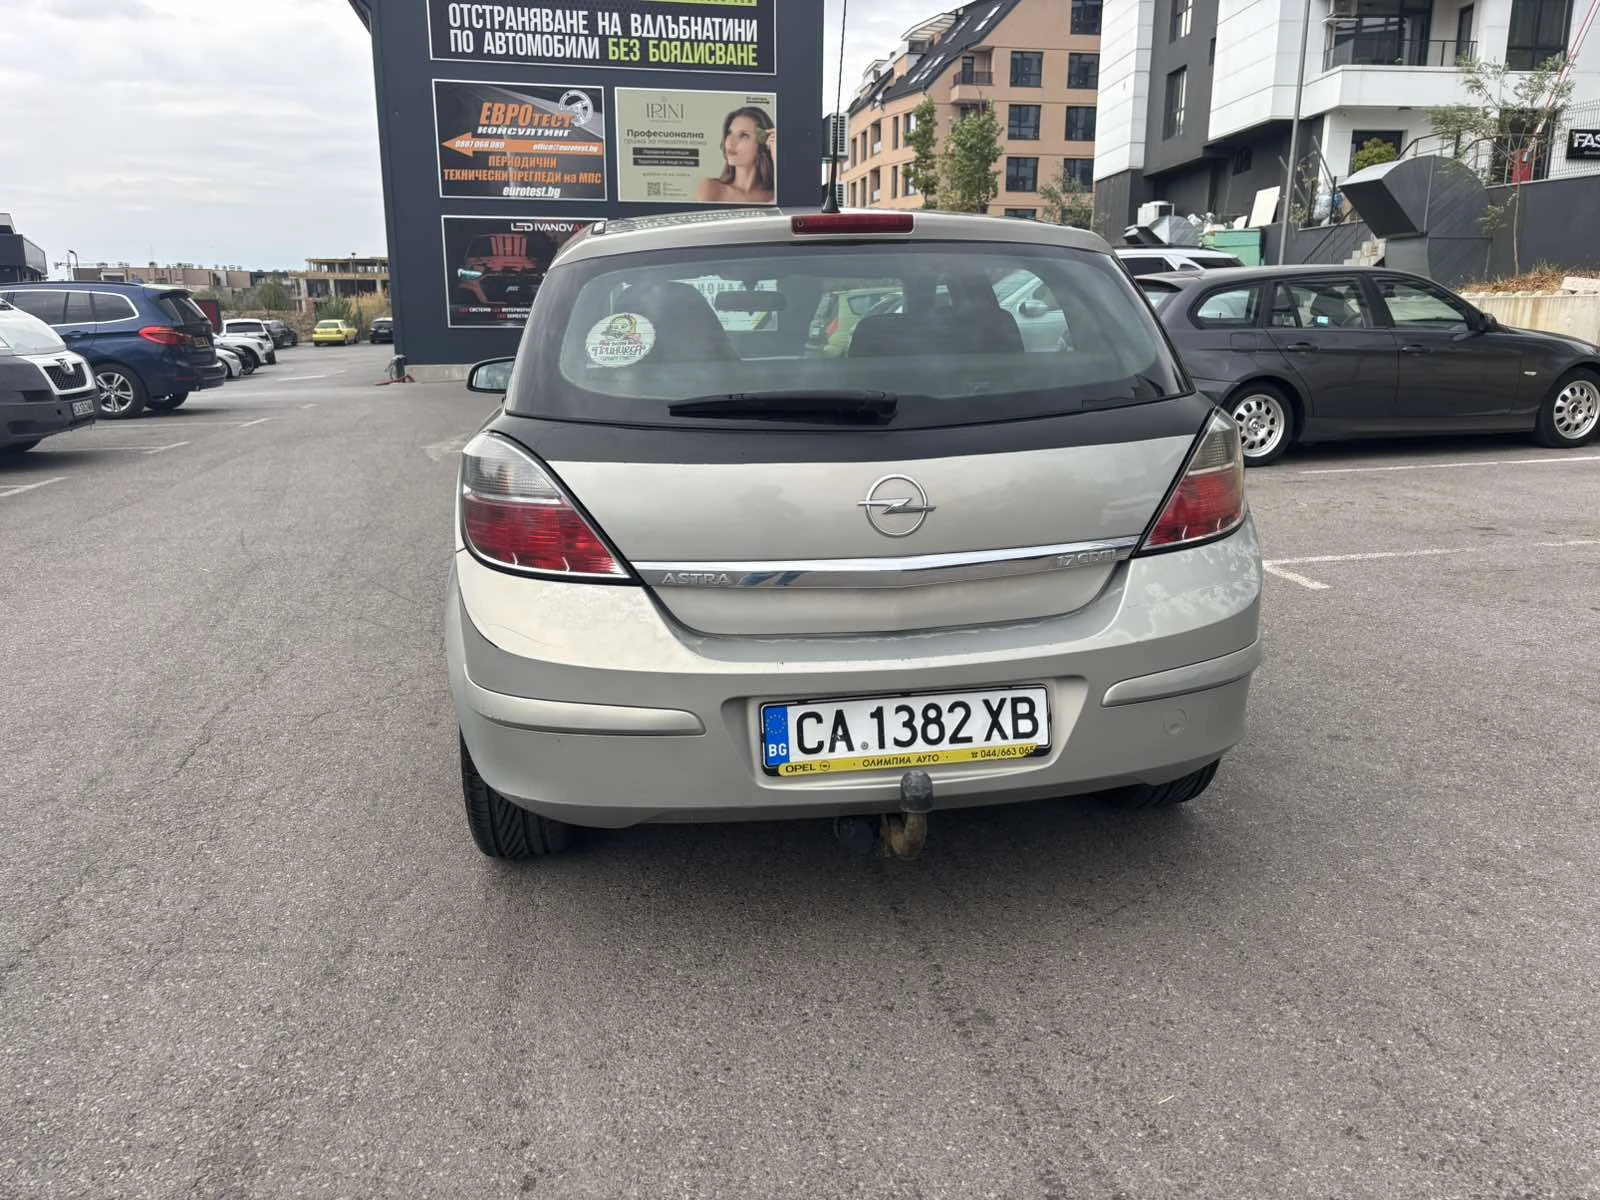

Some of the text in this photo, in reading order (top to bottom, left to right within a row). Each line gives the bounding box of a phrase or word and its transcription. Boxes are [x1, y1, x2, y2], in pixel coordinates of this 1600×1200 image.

[448, 3, 758, 43] ОТСТРАНЯВАНЕ НА ВДЛЪБНАТИНИ
[450, 29, 759, 67] ПО АВТОМОБИЛИ БЕЗ БОЯДИСВАНЕ
[477, 125, 572, 137] КОНСУЛТИНГ
[626, 129, 705, 139] Професионална
[488, 155, 557, 169] ПЕРИОДИЧНИ
[443, 169, 602, 184] ТЕХНИЧЕСКИ ПРЕГЛЕДИ на МПС
[502, 185, 561, 198] eurotest.bg
[661, 571, 730, 586] ASTRA
[870, 702, 973, 749] 1382
[768, 742, 788, 758] BG
[785, 762, 816, 774] OPEL
[862, 753, 940, 768] ОЛИМПИА АУТО
